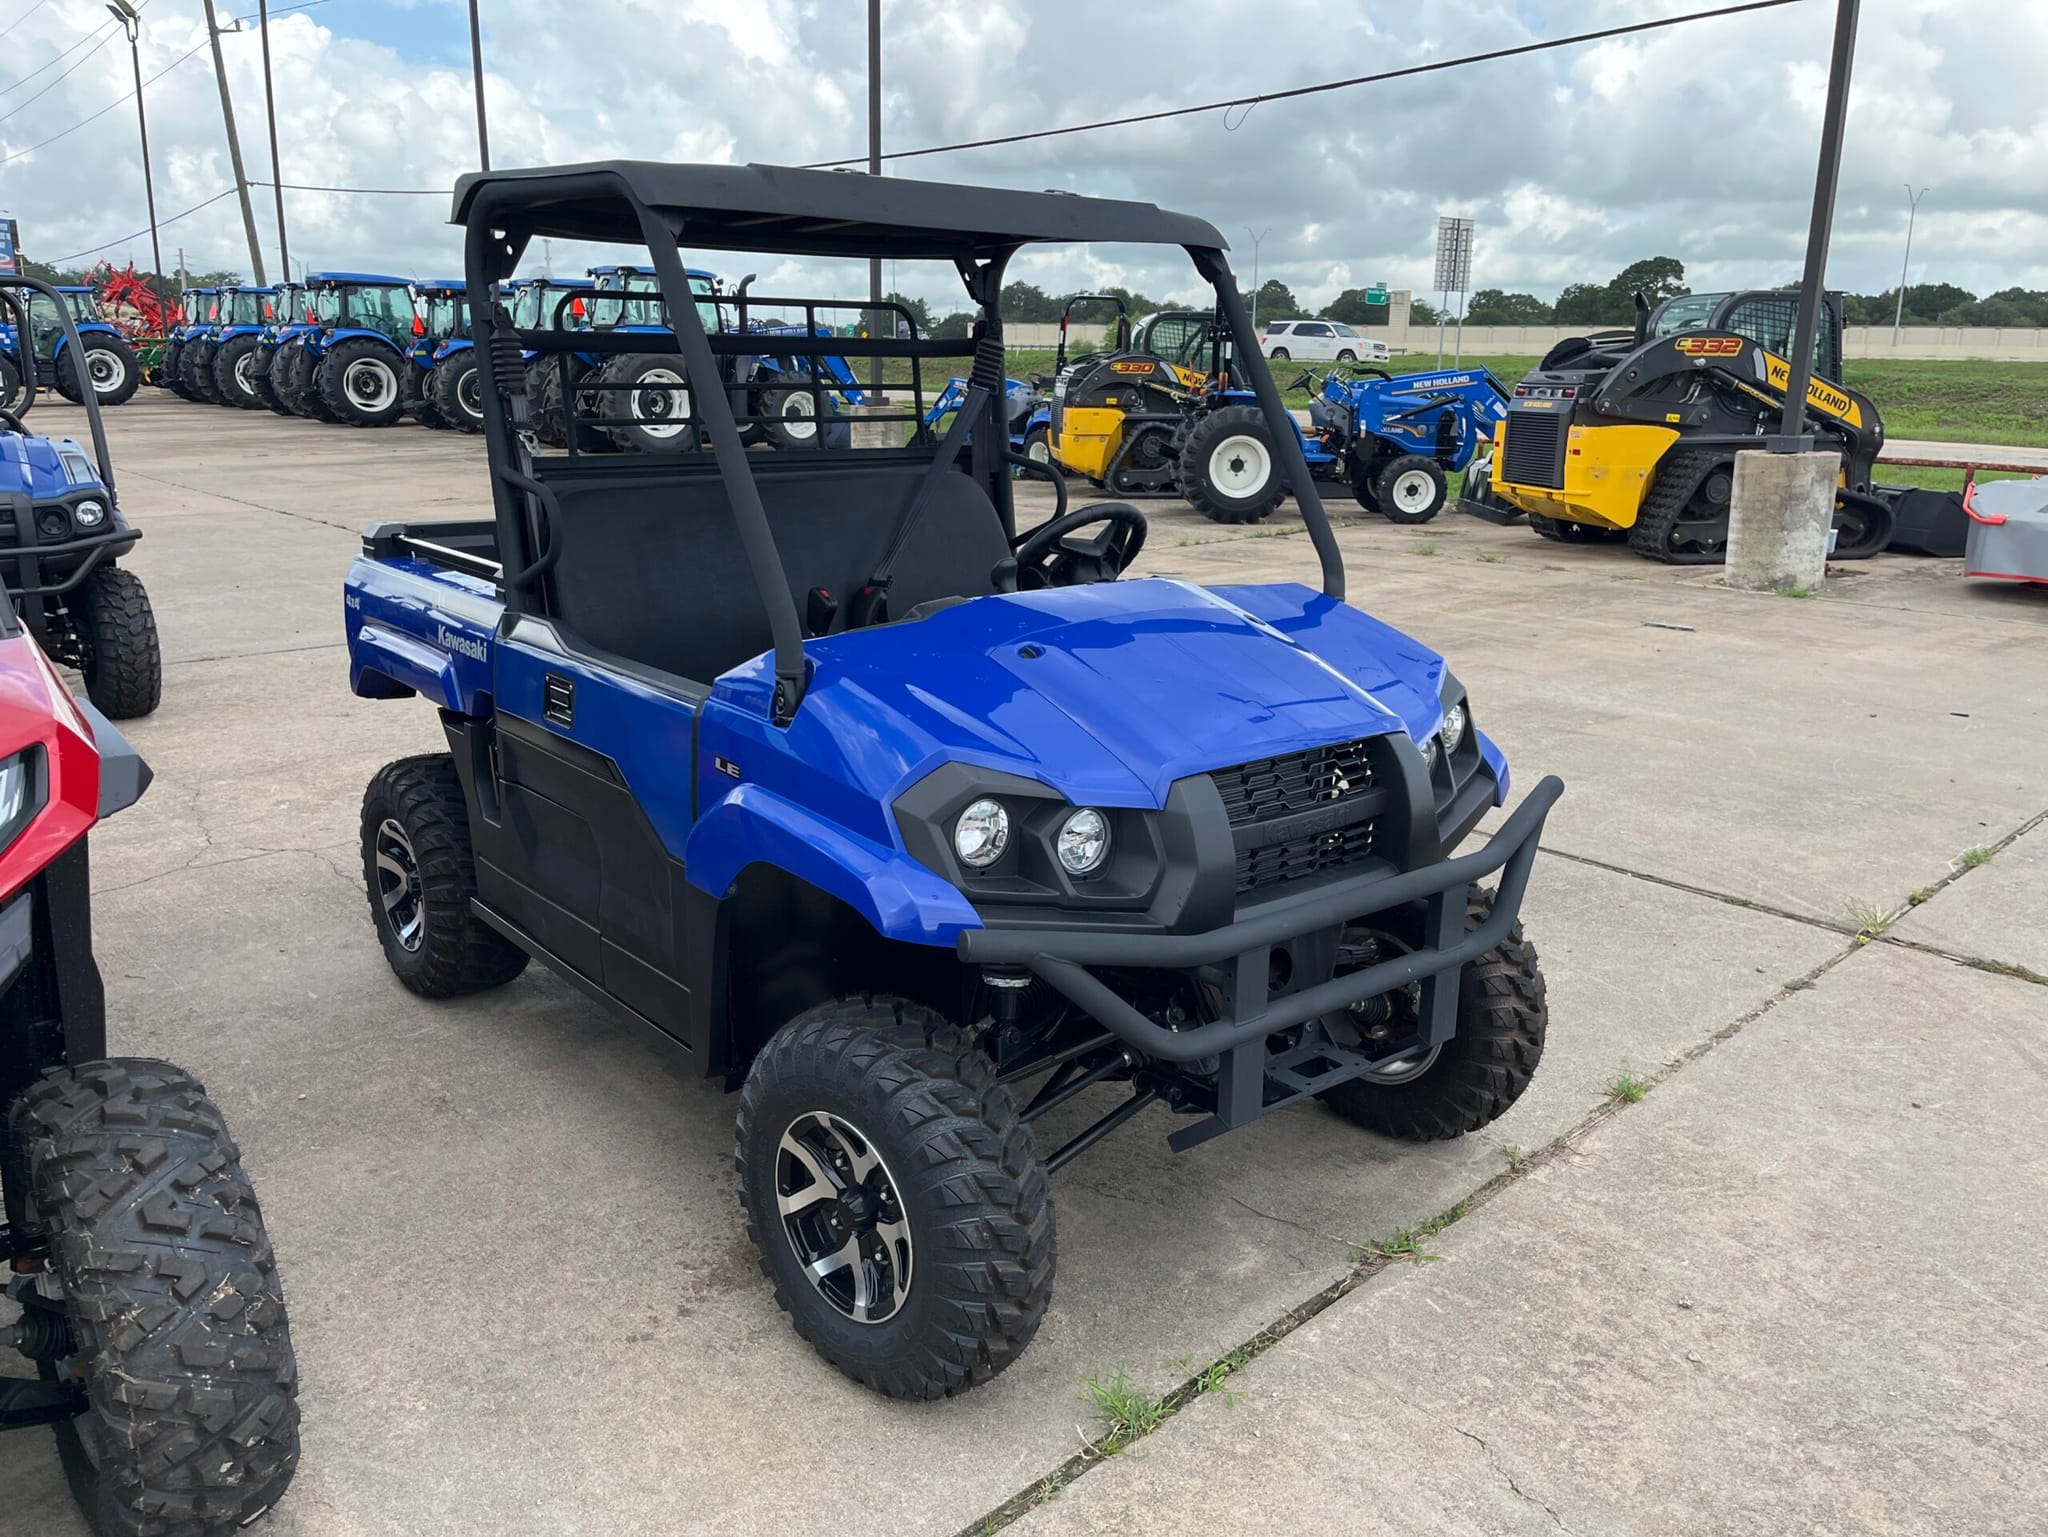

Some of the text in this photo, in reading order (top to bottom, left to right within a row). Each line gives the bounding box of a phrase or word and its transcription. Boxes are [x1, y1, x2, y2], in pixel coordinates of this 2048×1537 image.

[1675, 338, 1743, 356] C332
[1111, 362, 1154, 374] C330
[1413, 375, 1470, 389] NEW HOLLAND
[1771, 365, 1788, 382] NE
[1807, 383, 1847, 411] OLLAND
[438, 624, 487, 663] Kawasaki
[715, 757, 740, 779] LE
